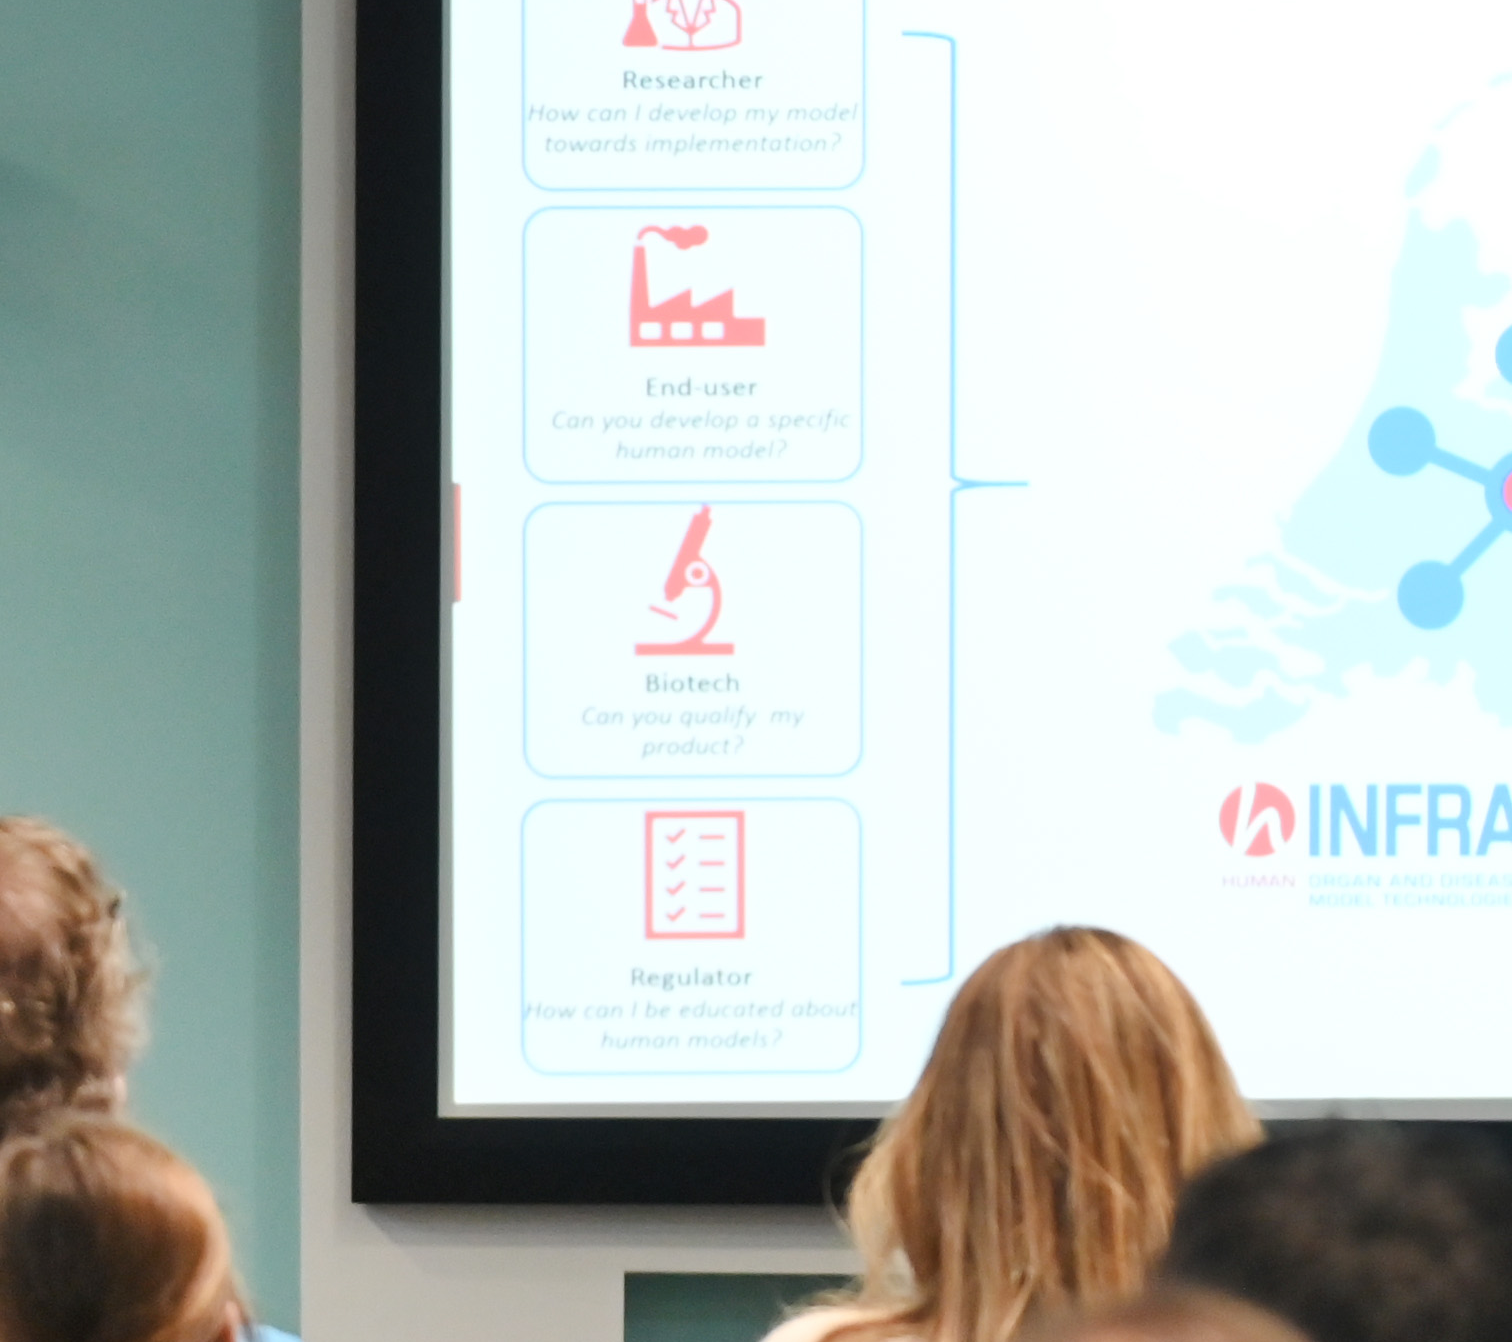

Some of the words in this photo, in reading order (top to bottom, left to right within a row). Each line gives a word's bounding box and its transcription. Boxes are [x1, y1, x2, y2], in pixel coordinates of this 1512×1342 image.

[623, 70, 763, 89] Researcher
[528, 104, 579, 122] How
[587, 108, 627, 122] can
[649, 104, 737, 126] develop
[746, 108, 779, 126] my
[786, 103, 859, 122] model
[545, 134, 637, 153] towards
[645, 132, 842, 157] implementation?
[645, 377, 759, 397] End-user
[551, 411, 594, 430] Can
[602, 414, 643, 432] you
[650, 410, 738, 432] develop
[746, 415, 760, 429] a
[768, 410, 851, 431] specific
[616, 441, 695, 460] human
[703, 439, 788, 459] model?
[645, 673, 740, 693] Biotech
[581, 707, 624, 726] Can
[632, 710, 672, 730] you
[680, 706, 757, 728] qualify
[769, 709, 805, 728] my
[641, 735, 745, 759] product?
[1222, 875, 1296, 889] HUMAN
[631, 967, 753, 992] Regulator
[525, 1002, 576, 1020] How
[583, 1005, 623, 1019] can
[645, 1001, 672, 1019] be
[679, 999, 785, 1019] educated
[791, 999, 859, 1018] about
[601, 1030, 680, 1049] human
[688, 1029, 784, 1048] models?
